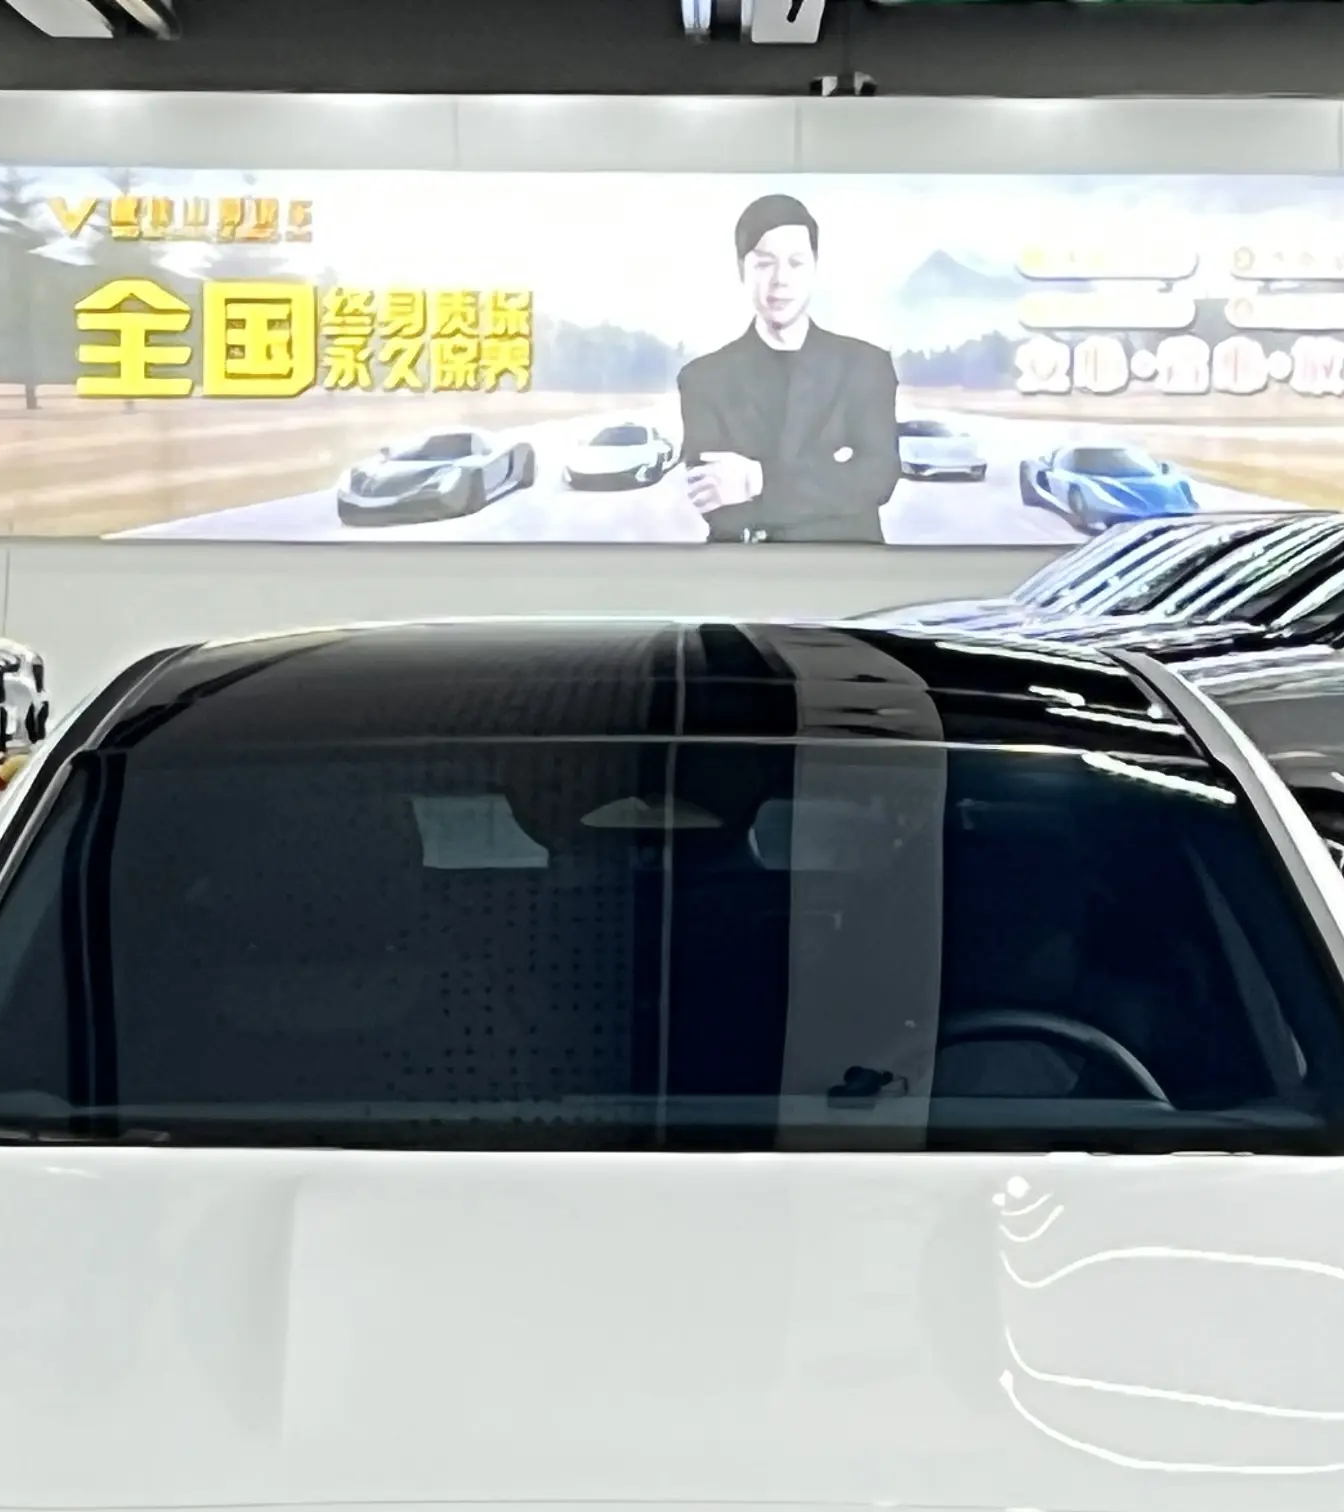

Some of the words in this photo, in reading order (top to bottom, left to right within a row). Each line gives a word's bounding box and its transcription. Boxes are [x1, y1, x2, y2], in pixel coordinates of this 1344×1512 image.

[74, 278, 317, 399] 全国
[320, 286, 534, 338] 终身质保
[320, 335, 534, 393] 永久保养
